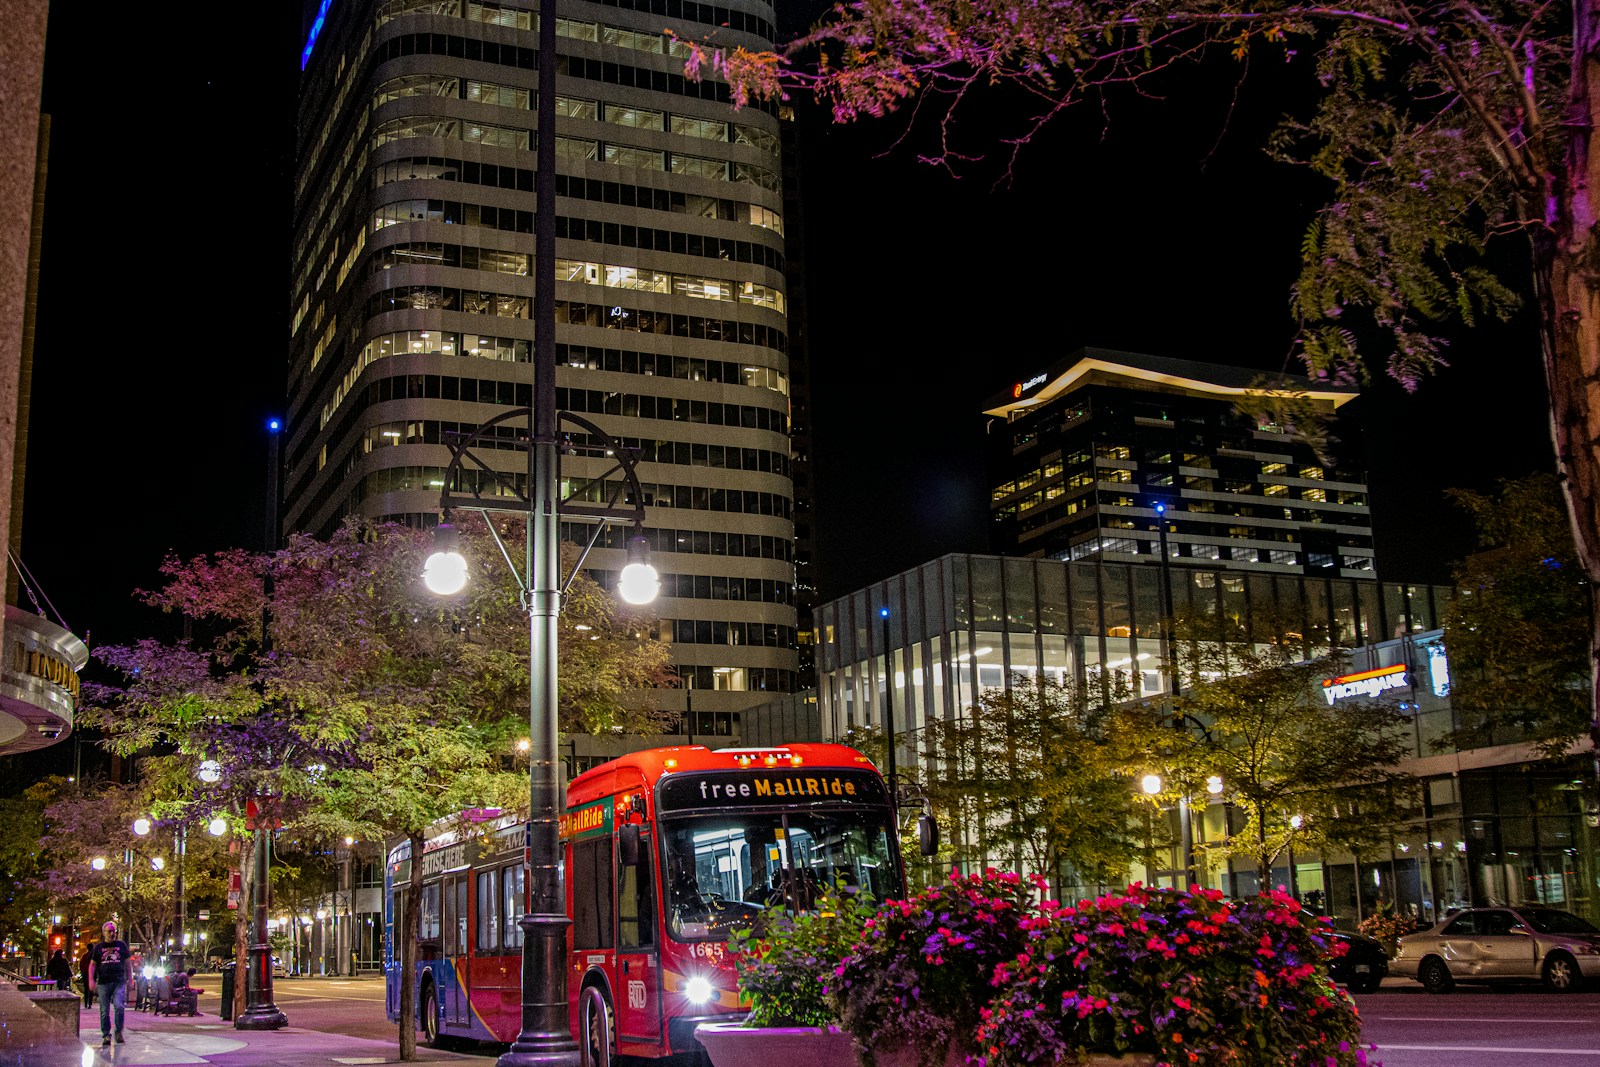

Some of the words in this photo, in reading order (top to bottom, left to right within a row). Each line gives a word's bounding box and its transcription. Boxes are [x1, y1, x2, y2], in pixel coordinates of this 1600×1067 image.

[754, 777, 855, 797] MallRide
[445, 844, 466, 868] HERE
[688, 943, 722, 958] 1665
[628, 980, 647, 1009] RTD
